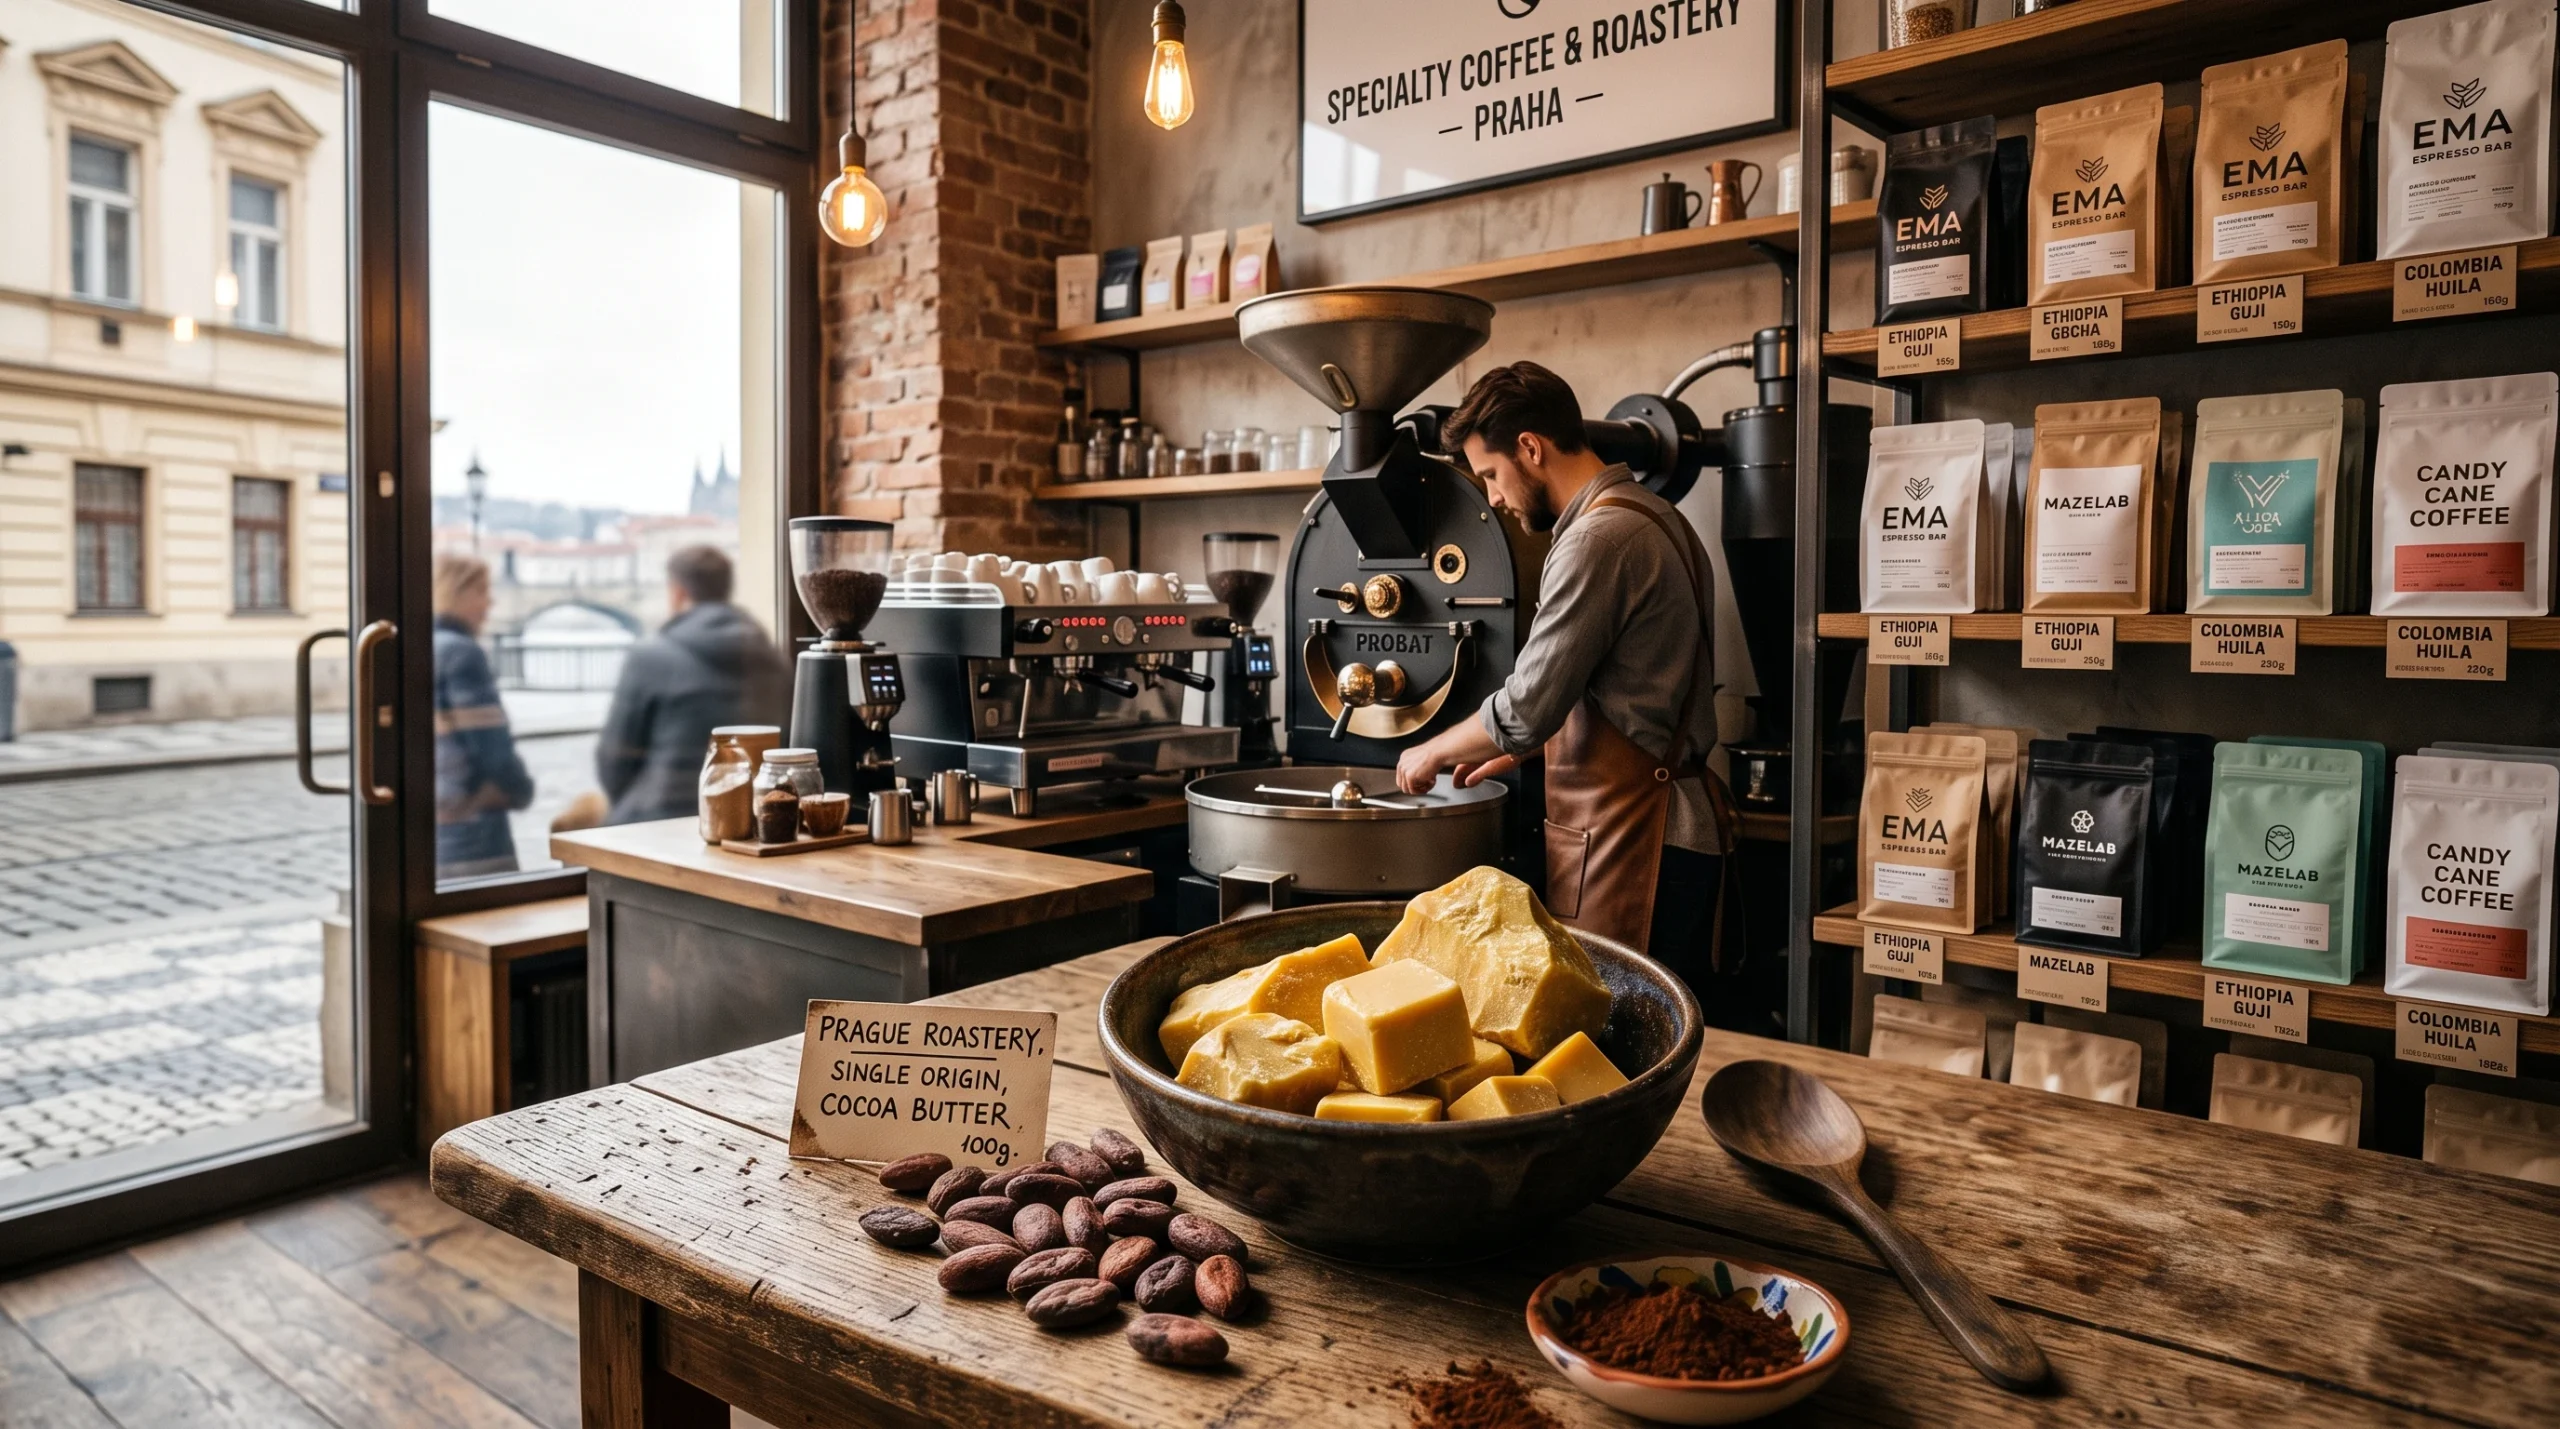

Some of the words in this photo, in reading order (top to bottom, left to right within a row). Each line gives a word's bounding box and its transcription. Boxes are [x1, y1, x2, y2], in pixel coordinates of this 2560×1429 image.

[1327, 60, 1452, 125] SPECIALTY
[1460, 32, 1556, 92] COFFEE
[1565, 26, 1583, 65] &
[1592, 0, 1740, 59] ROASTERY
[1474, 86, 1563, 141] PRAHA
[2412, 108, 2514, 150] EMA
[2412, 146, 2480, 165] ESPRESSO
[2484, 141, 2513, 152] BAR
[2222, 151, 2309, 188] EMA
[2051, 183, 2126, 217] EMA
[2221, 185, 2280, 201] ESPRESSO
[2283, 181, 2308, 191] BAR
[1896, 211, 1962, 242] EMA
[2051, 215, 2102, 229] ESPRESSO
[2105, 211, 2126, 220] BAR
[1895, 240, 1940, 252] ESPRESSO
[1941, 237, 1961, 246] BAR
[2404, 255, 2503, 281] COLOMBIA
[2211, 283, 2287, 306] ETHIOPIA
[2425, 277, 2482, 298] HUILA
[2042, 305, 2109, 325] ETHIOPIA
[2229, 303, 2266, 320] GUJI
[1888, 325, 1949, 344] ETHIOPIA
[2272, 320, 2296, 332] 150g
[1903, 343, 1933, 358] GUJI
[2416, 460, 2508, 483] CANDY
[2044, 494, 2130, 511] MAZELAB
[2425, 484, 2496, 504] CANE
[1882, 505, 1949, 530] EMA
[2410, 506, 2511, 528] COFFEE
[1881, 533, 1925, 542] ESPRESSO
[1928, 533, 1947, 541] BAR
[1880, 620, 1939, 634] ETHIOPIA
[2034, 621, 2100, 636] ETHIOPIA
[2200, 623, 2285, 639] COLOMBIA
[2397, 625, 2493, 642] COLOMBIA
[1356, 633, 1433, 654] PROBAT
[1894, 635, 1923, 648] GUJI
[2050, 637, 2083, 652] GUJI
[2217, 640, 2266, 656] HUILA
[2416, 643, 2473, 660] HUILA
[2083, 655, 2105, 667] 250g
[2260, 659, 2285, 671] 230g
[1882, 814, 1949, 845] EMA
[2042, 836, 2117, 855] MAZELAB
[2427, 843, 2511, 867] CANDY
[2237, 863, 2320, 882] MAZELAB
[2434, 866, 2501, 888] CANE
[2420, 886, 2515, 912] COFFEE
[1873, 932, 1931, 953] ETHIOPIA
[1887, 949, 1915, 964] GUJI
[2029, 954, 2095, 976] MAZELAB
[2215, 980, 2295, 1006] ETHIOPIA
[2233, 1001, 2271, 1019] GUJI
[2407, 1009, 2502, 1038] COLOMBIA
[819, 1015, 911, 1045] PRAGUE
[923, 1022, 1044, 1058] ROASTERY,
[2424, 1029, 2477, 1052] HUILA
[830, 1059, 910, 1085] SINGLE
[921, 1066, 1008, 1096] ORIGIN,
[820, 1092, 898, 1120] COCOA
